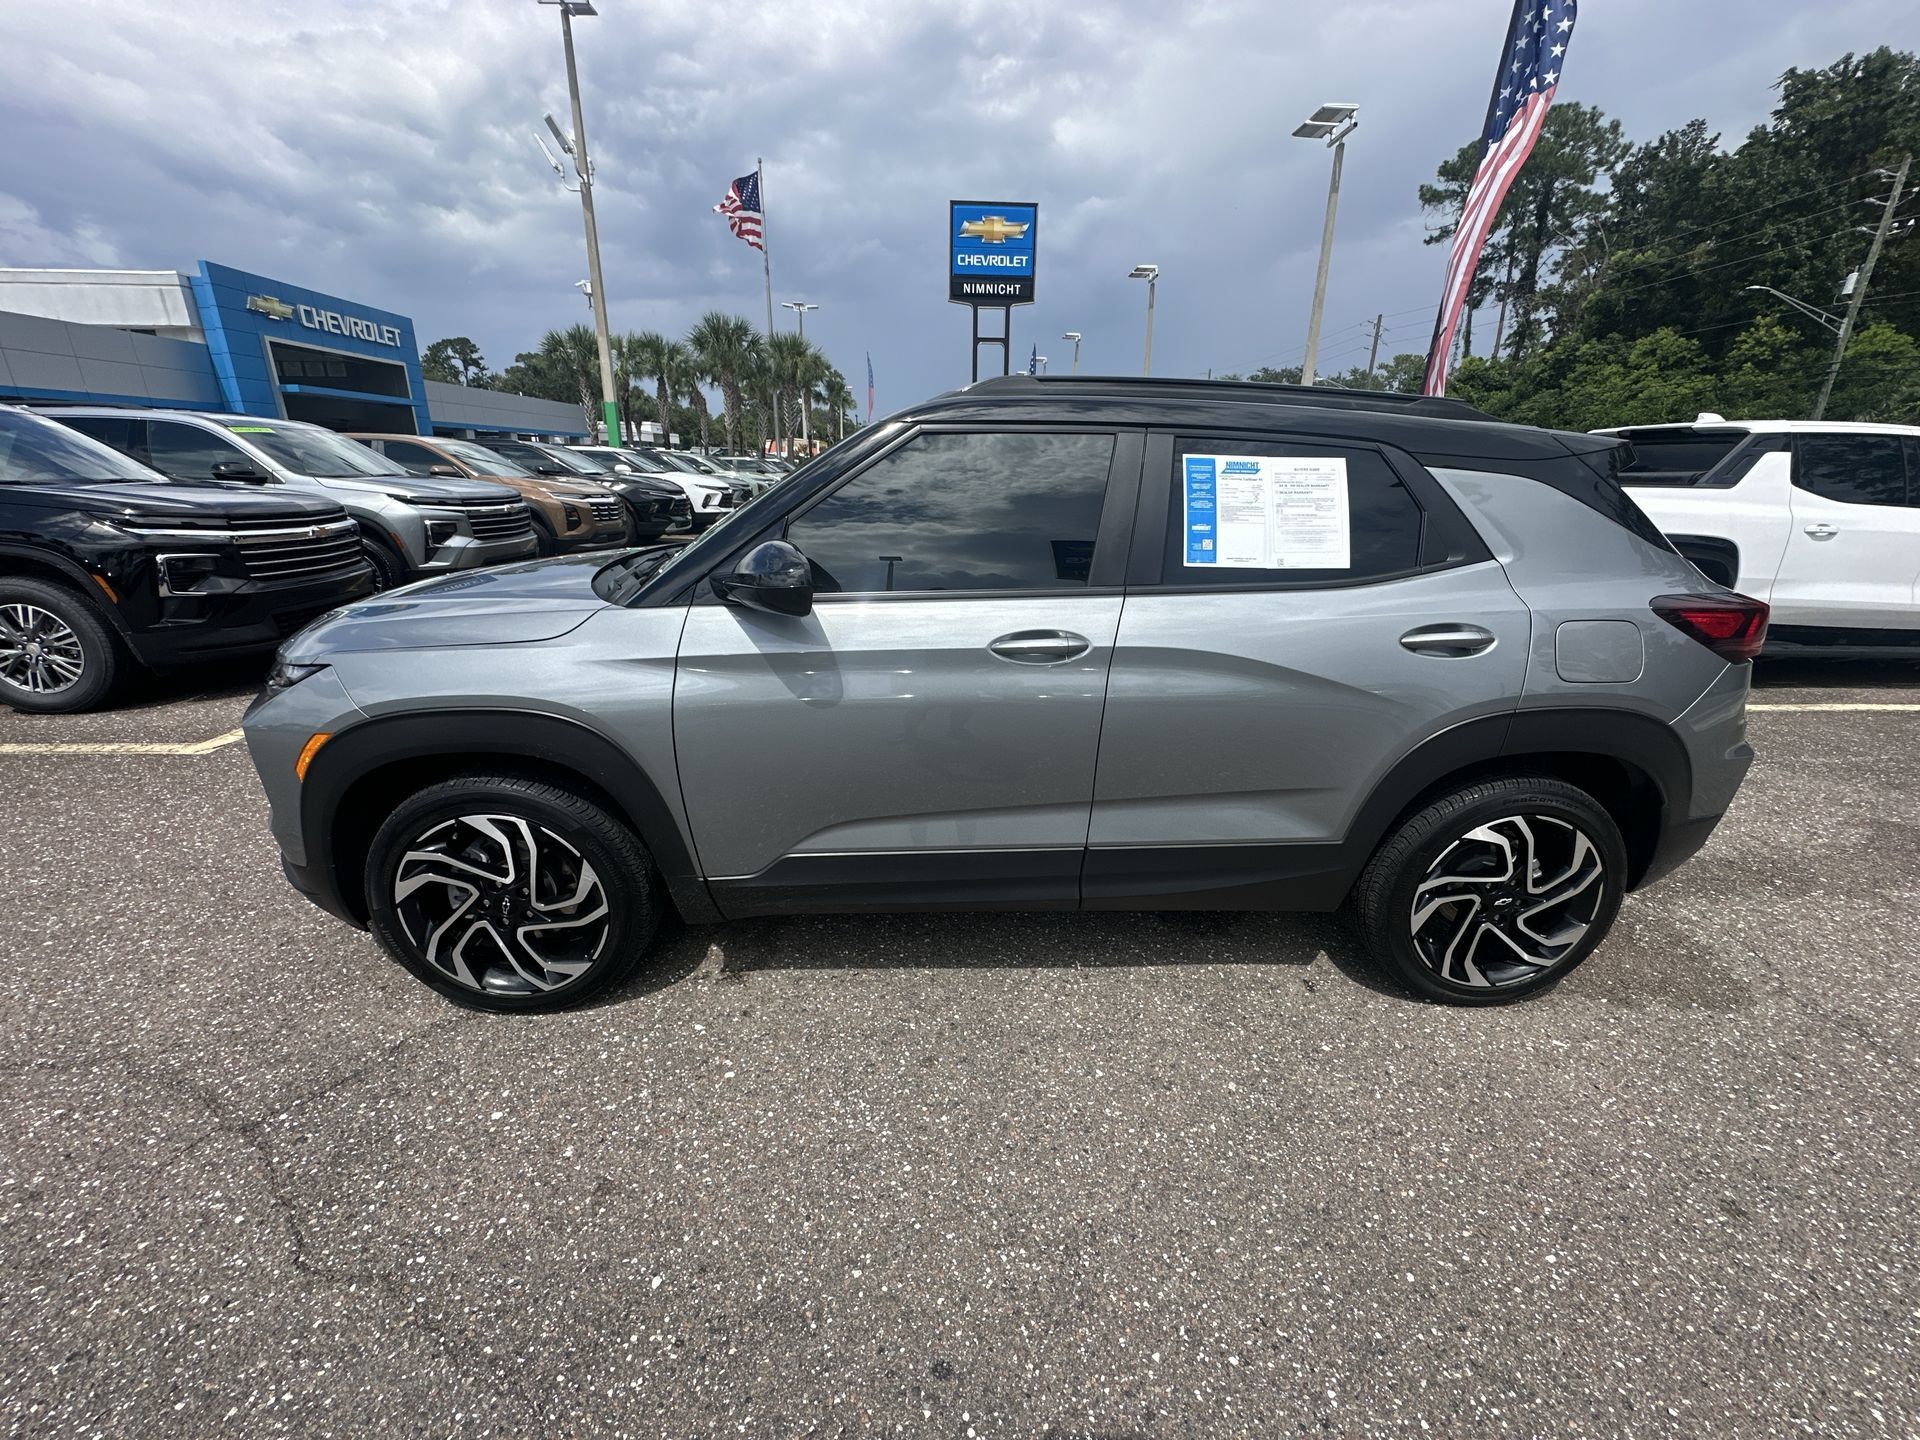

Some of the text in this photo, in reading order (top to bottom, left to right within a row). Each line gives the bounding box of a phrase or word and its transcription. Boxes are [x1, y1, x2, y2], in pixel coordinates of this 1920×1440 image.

[957, 254, 1029, 267] CHEVROLET
[963, 283, 1021, 295] NIMNICHT
[297, 304, 401, 348] CHEVROLET
[1225, 461, 1260, 470] NIMNICHT
